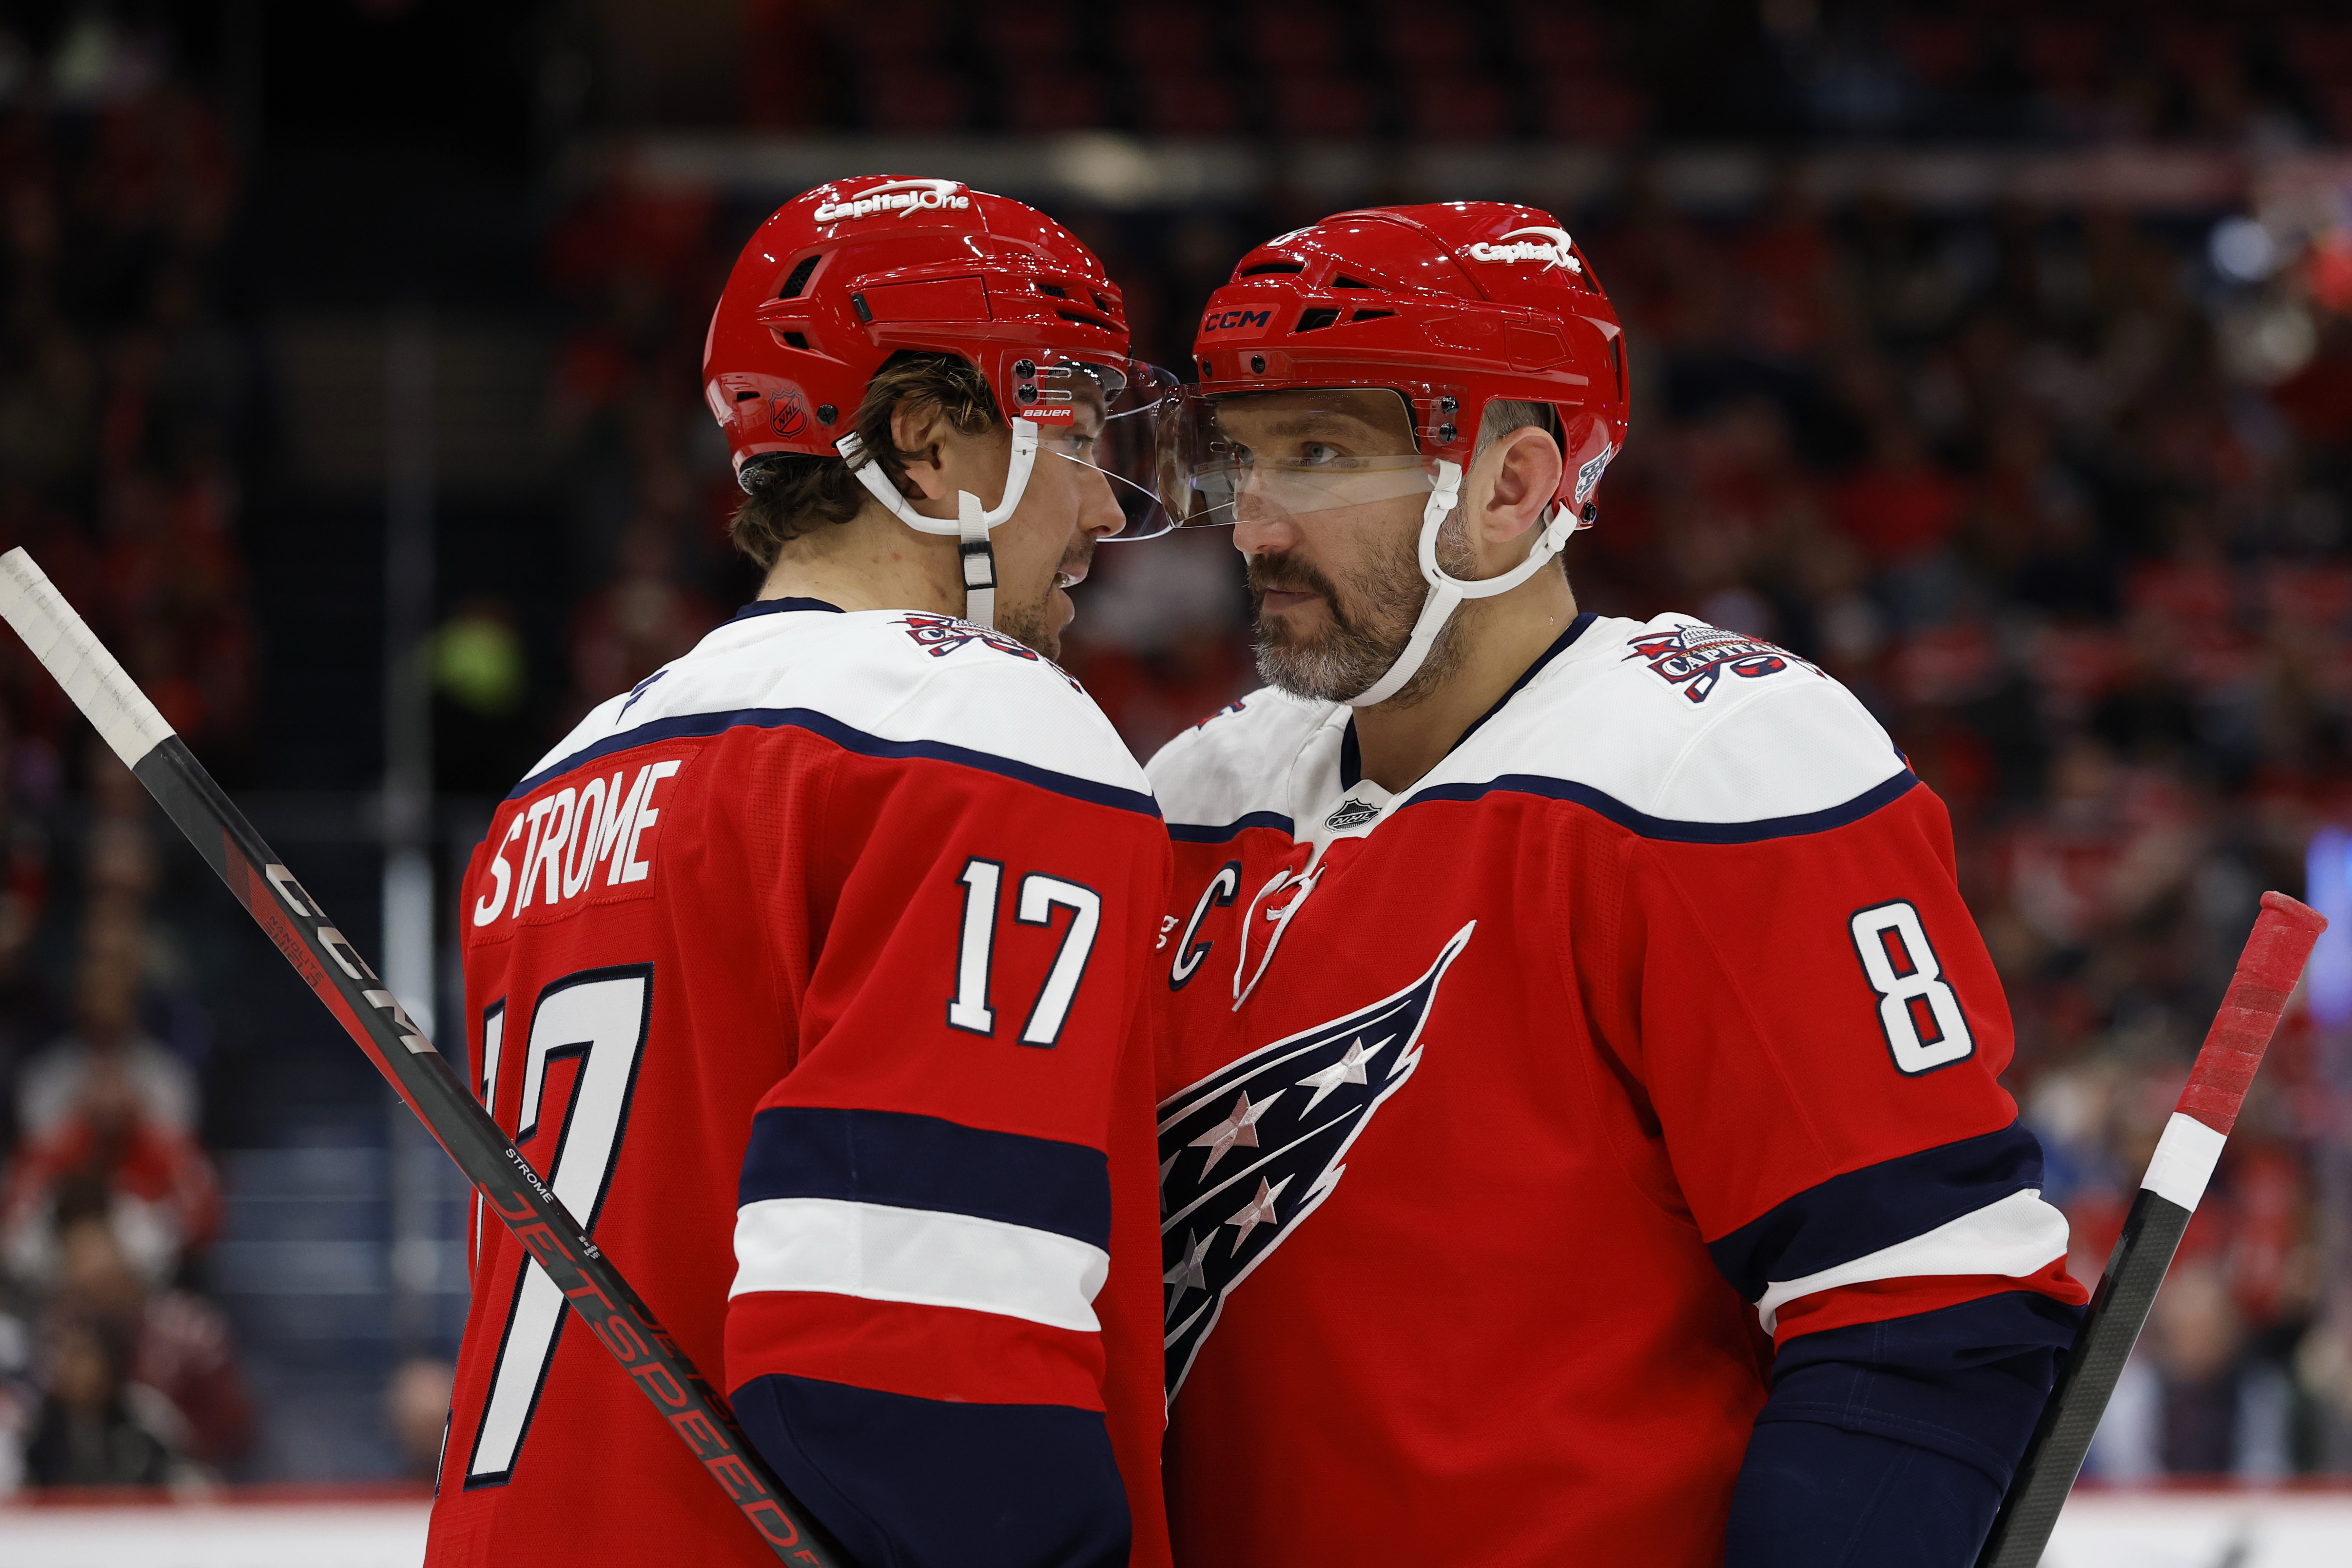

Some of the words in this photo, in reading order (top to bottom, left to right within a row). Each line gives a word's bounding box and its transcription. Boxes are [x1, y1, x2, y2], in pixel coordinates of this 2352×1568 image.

[1205, 311, 1272, 332] CCM
[779, 401, 798, 428] NHL
[473, 760, 682, 927] STROME
[1332, 813, 1370, 825] NHL
[264, 920, 319, 988] SHIELD
[266, 864, 438, 1054] CCM
[269, 917, 324, 981] NANOLITE
[946, 854, 1102, 1049] 17
[1168, 860, 1243, 991] C
[1847, 897, 1976, 1078] 8
[505, 1148, 554, 1203] STROME
[478, 1181, 799, 1547] JETSPEED
